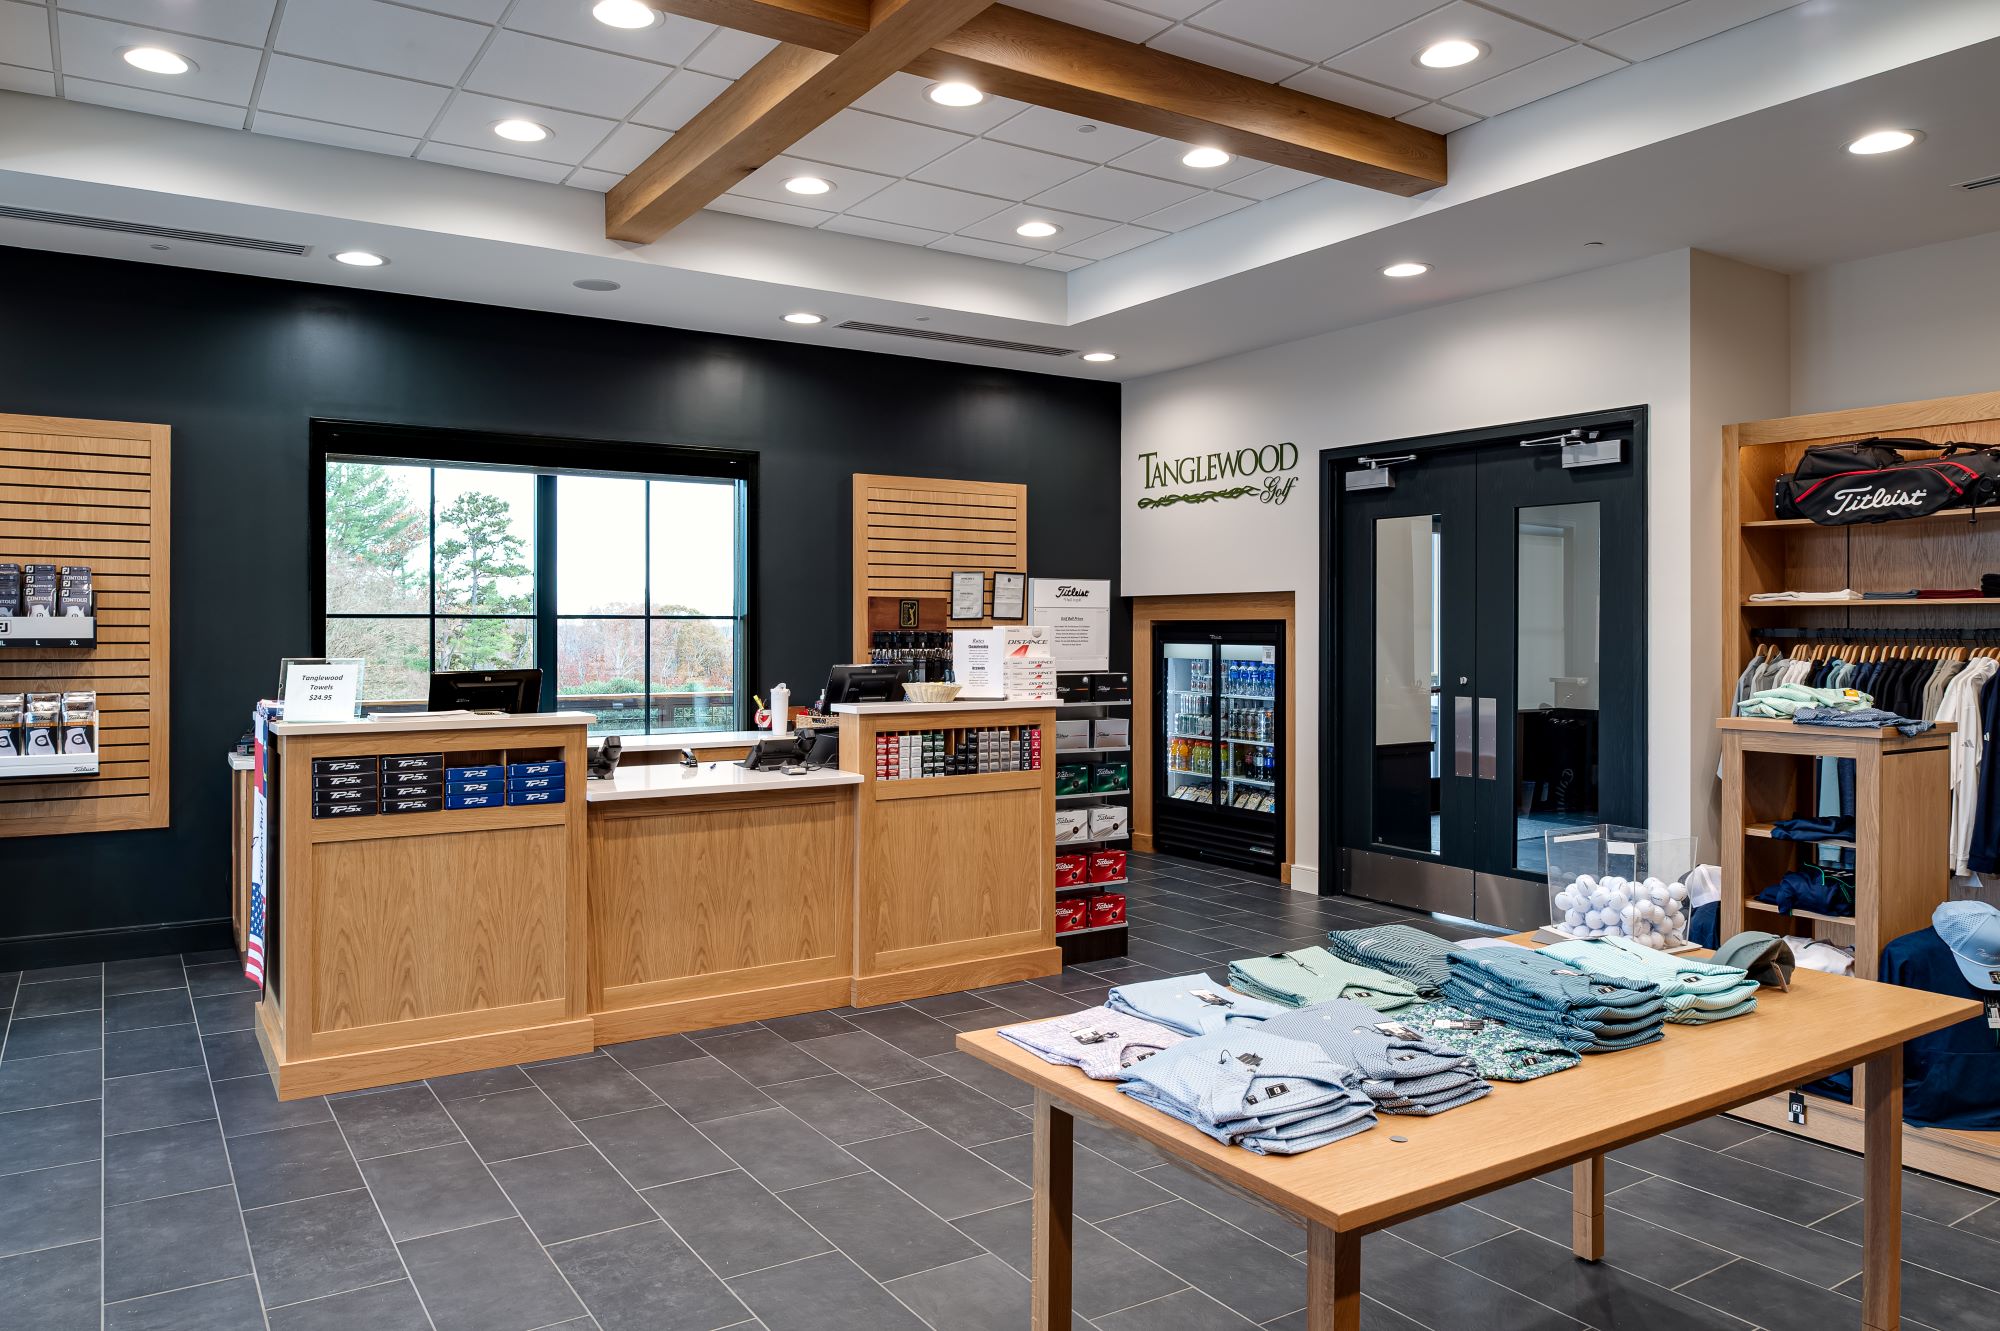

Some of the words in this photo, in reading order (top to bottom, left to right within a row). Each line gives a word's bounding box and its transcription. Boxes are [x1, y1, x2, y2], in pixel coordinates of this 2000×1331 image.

[1137, 441, 1300, 490] TANGLEWOOD
[1259, 475, 1300, 506] Golf
[1826, 485, 1927, 516] Titleist
[1055, 585, 1090, 598] Titleist
[302, 674, 344, 682] Tanglewood
[328, 762, 361, 771] TP5x
[398, 759, 428, 768] TP5x
[463, 770, 488, 778] TP5
[526, 765, 550, 774] TP5
[330, 776, 362, 785] TP5x
[398, 773, 428, 782] TP5x
[463, 784, 488, 792] TP5
[525, 779, 550, 788] TP5
[330, 790, 362, 799] TP5x
[396, 786, 428, 796] TP5x
[463, 796, 488, 805] TP5
[526, 792, 550, 801] TP5
[330, 804, 362, 814] TP5x
[397, 800, 428, 810] TP5x
